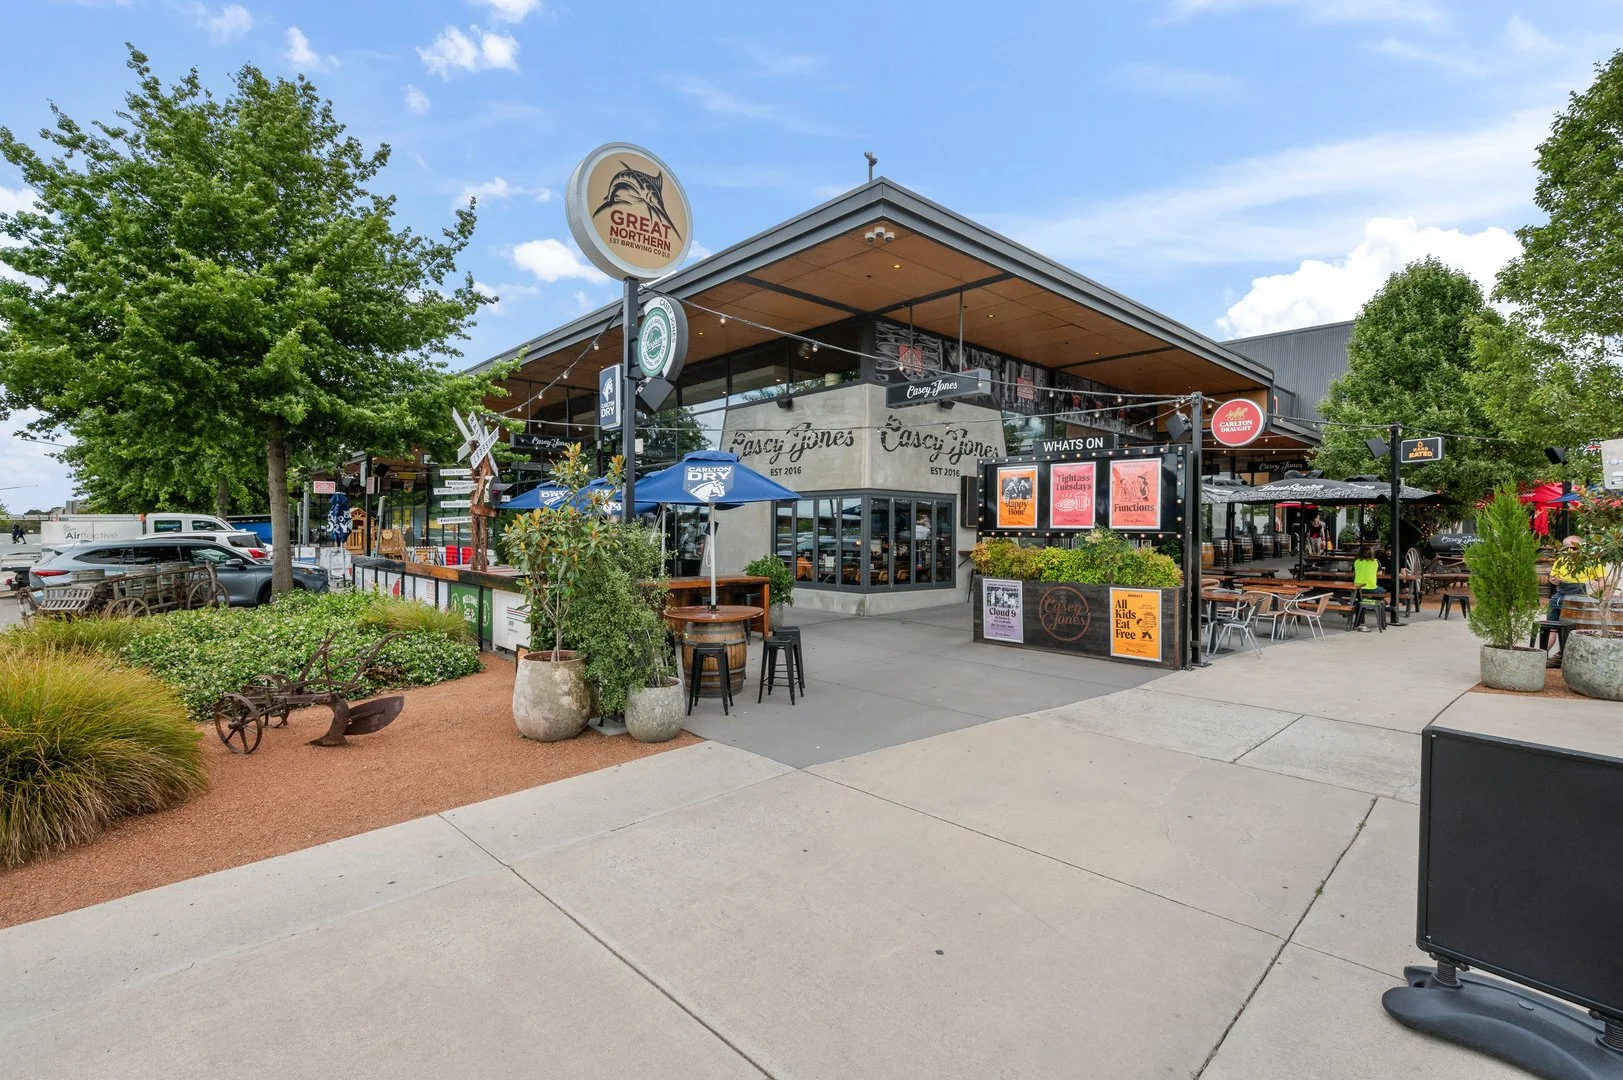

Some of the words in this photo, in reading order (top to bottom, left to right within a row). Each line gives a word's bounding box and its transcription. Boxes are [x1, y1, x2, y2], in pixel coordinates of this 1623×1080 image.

[610, 209, 671, 239] GREAT
[609, 225, 671, 252] NORTHERN
[620, 239, 653, 254] BREWING
[906, 384, 931, 399] Casey
[931, 379, 958, 397] Jones
[601, 405, 615, 418] DRY
[1219, 419, 1253, 428] CARLTON
[1220, 425, 1252, 433] DRAUGHT
[786, 422, 855, 463] Jones
[881, 414, 944, 463] Casey
[945, 428, 999, 465] Jones
[1043, 438, 1083, 453] WHATS
[1086, 436, 1104, 450] ON
[1408, 451, 1433, 459] RATED
[770, 468, 783, 477] EST
[784, 466, 802, 475] 2016
[930, 466, 943, 476] EST
[943, 468, 960, 478] 2016
[1259, 462, 1280, 471] Casey
[687, 471, 731, 480] DRY
[1056, 474, 1091, 484] Tightass
[1056, 482, 1092, 491] Tuesdays
[1008, 508, 1025, 516] Hour
[1114, 502, 1155, 512] Functions
[1441, 535, 1462, 544] Casey
[1115, 599, 1128, 609] All
[989, 607, 1010, 617] Cloud
[1010, 609, 1017, 618] 9
[1115, 608, 1137, 620] Kids
[1115, 619, 1130, 629] Eat
[1115, 628, 1136, 640] Free
